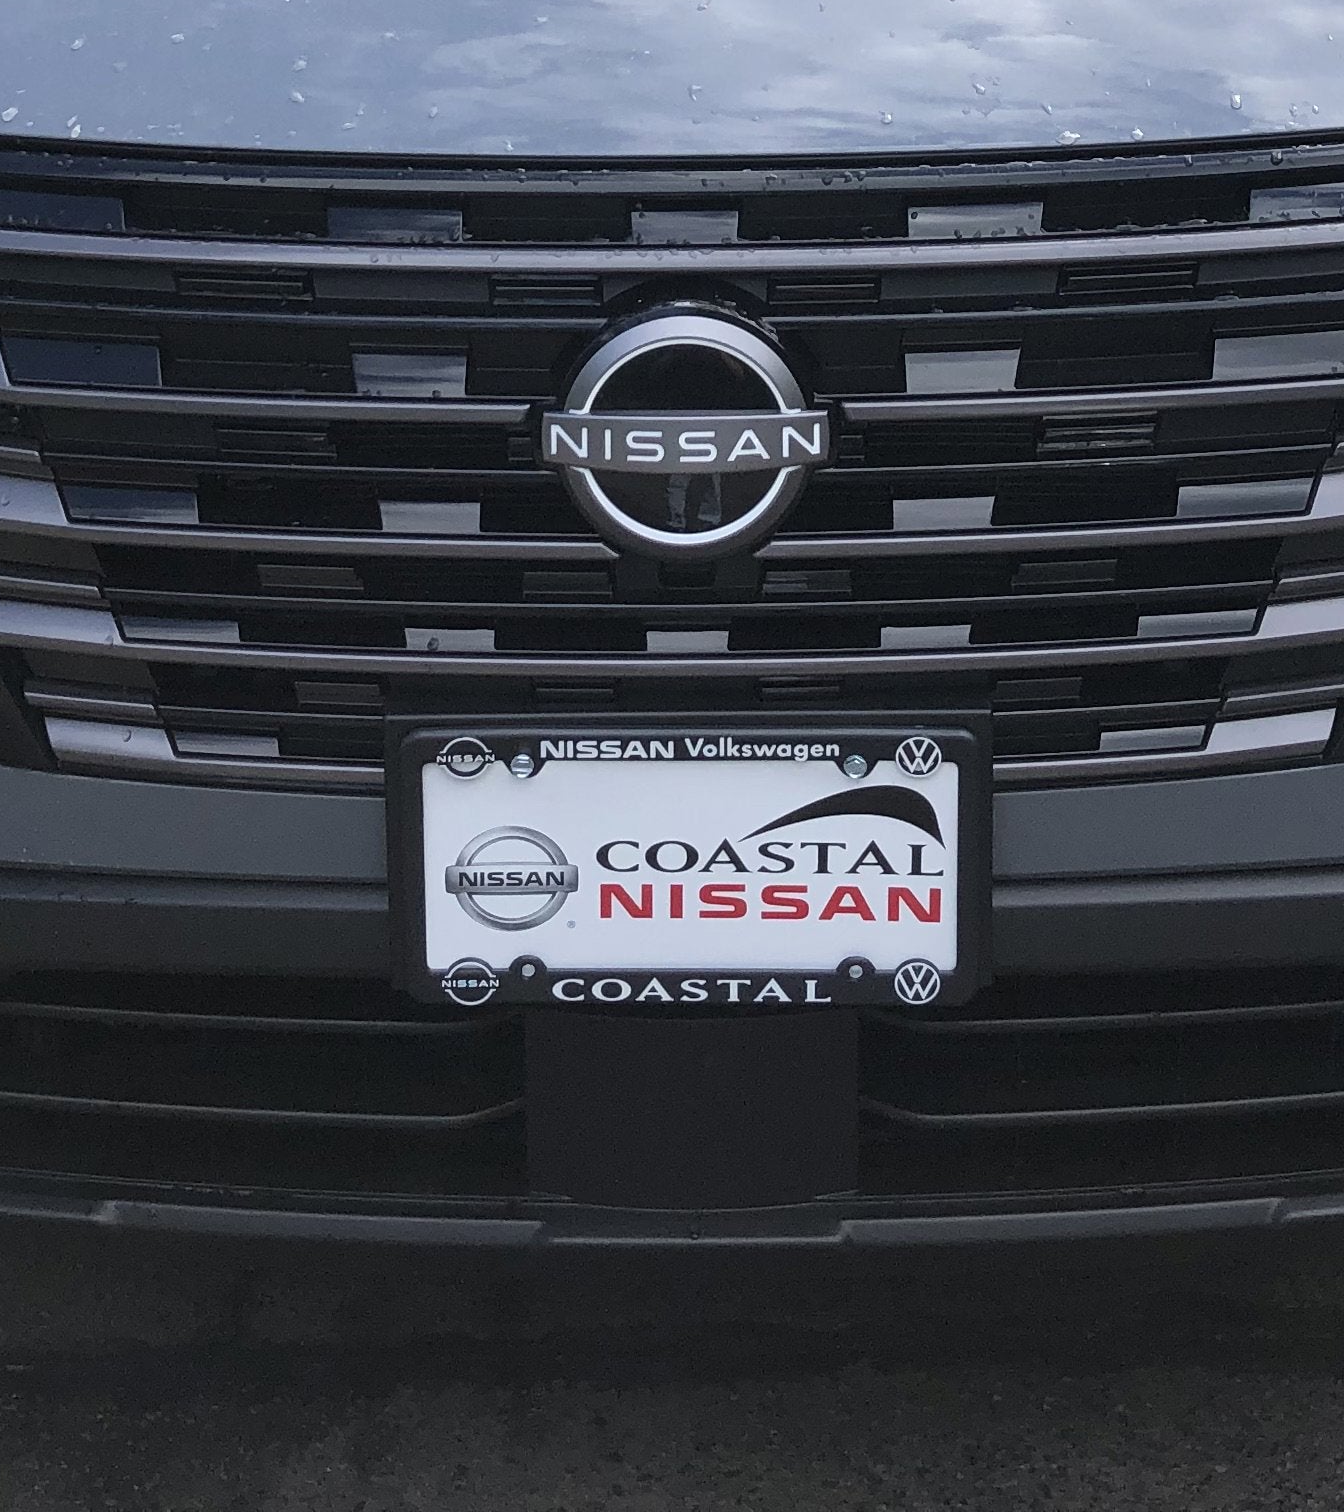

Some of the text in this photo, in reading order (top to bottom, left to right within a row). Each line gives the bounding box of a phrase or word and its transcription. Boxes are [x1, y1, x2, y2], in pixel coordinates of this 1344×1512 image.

[549, 422, 821, 463] NISSAN
[436, 753, 496, 764] NISSAN
[540, 737, 841, 762] NISSAN Volkswagen
[596, 838, 945, 877] COASTAL
[458, 868, 566, 888] NISSAN
[598, 882, 942, 924] NISSAN
[441, 978, 500, 988] NISSAN
[552, 977, 832, 1003] COASTAL
